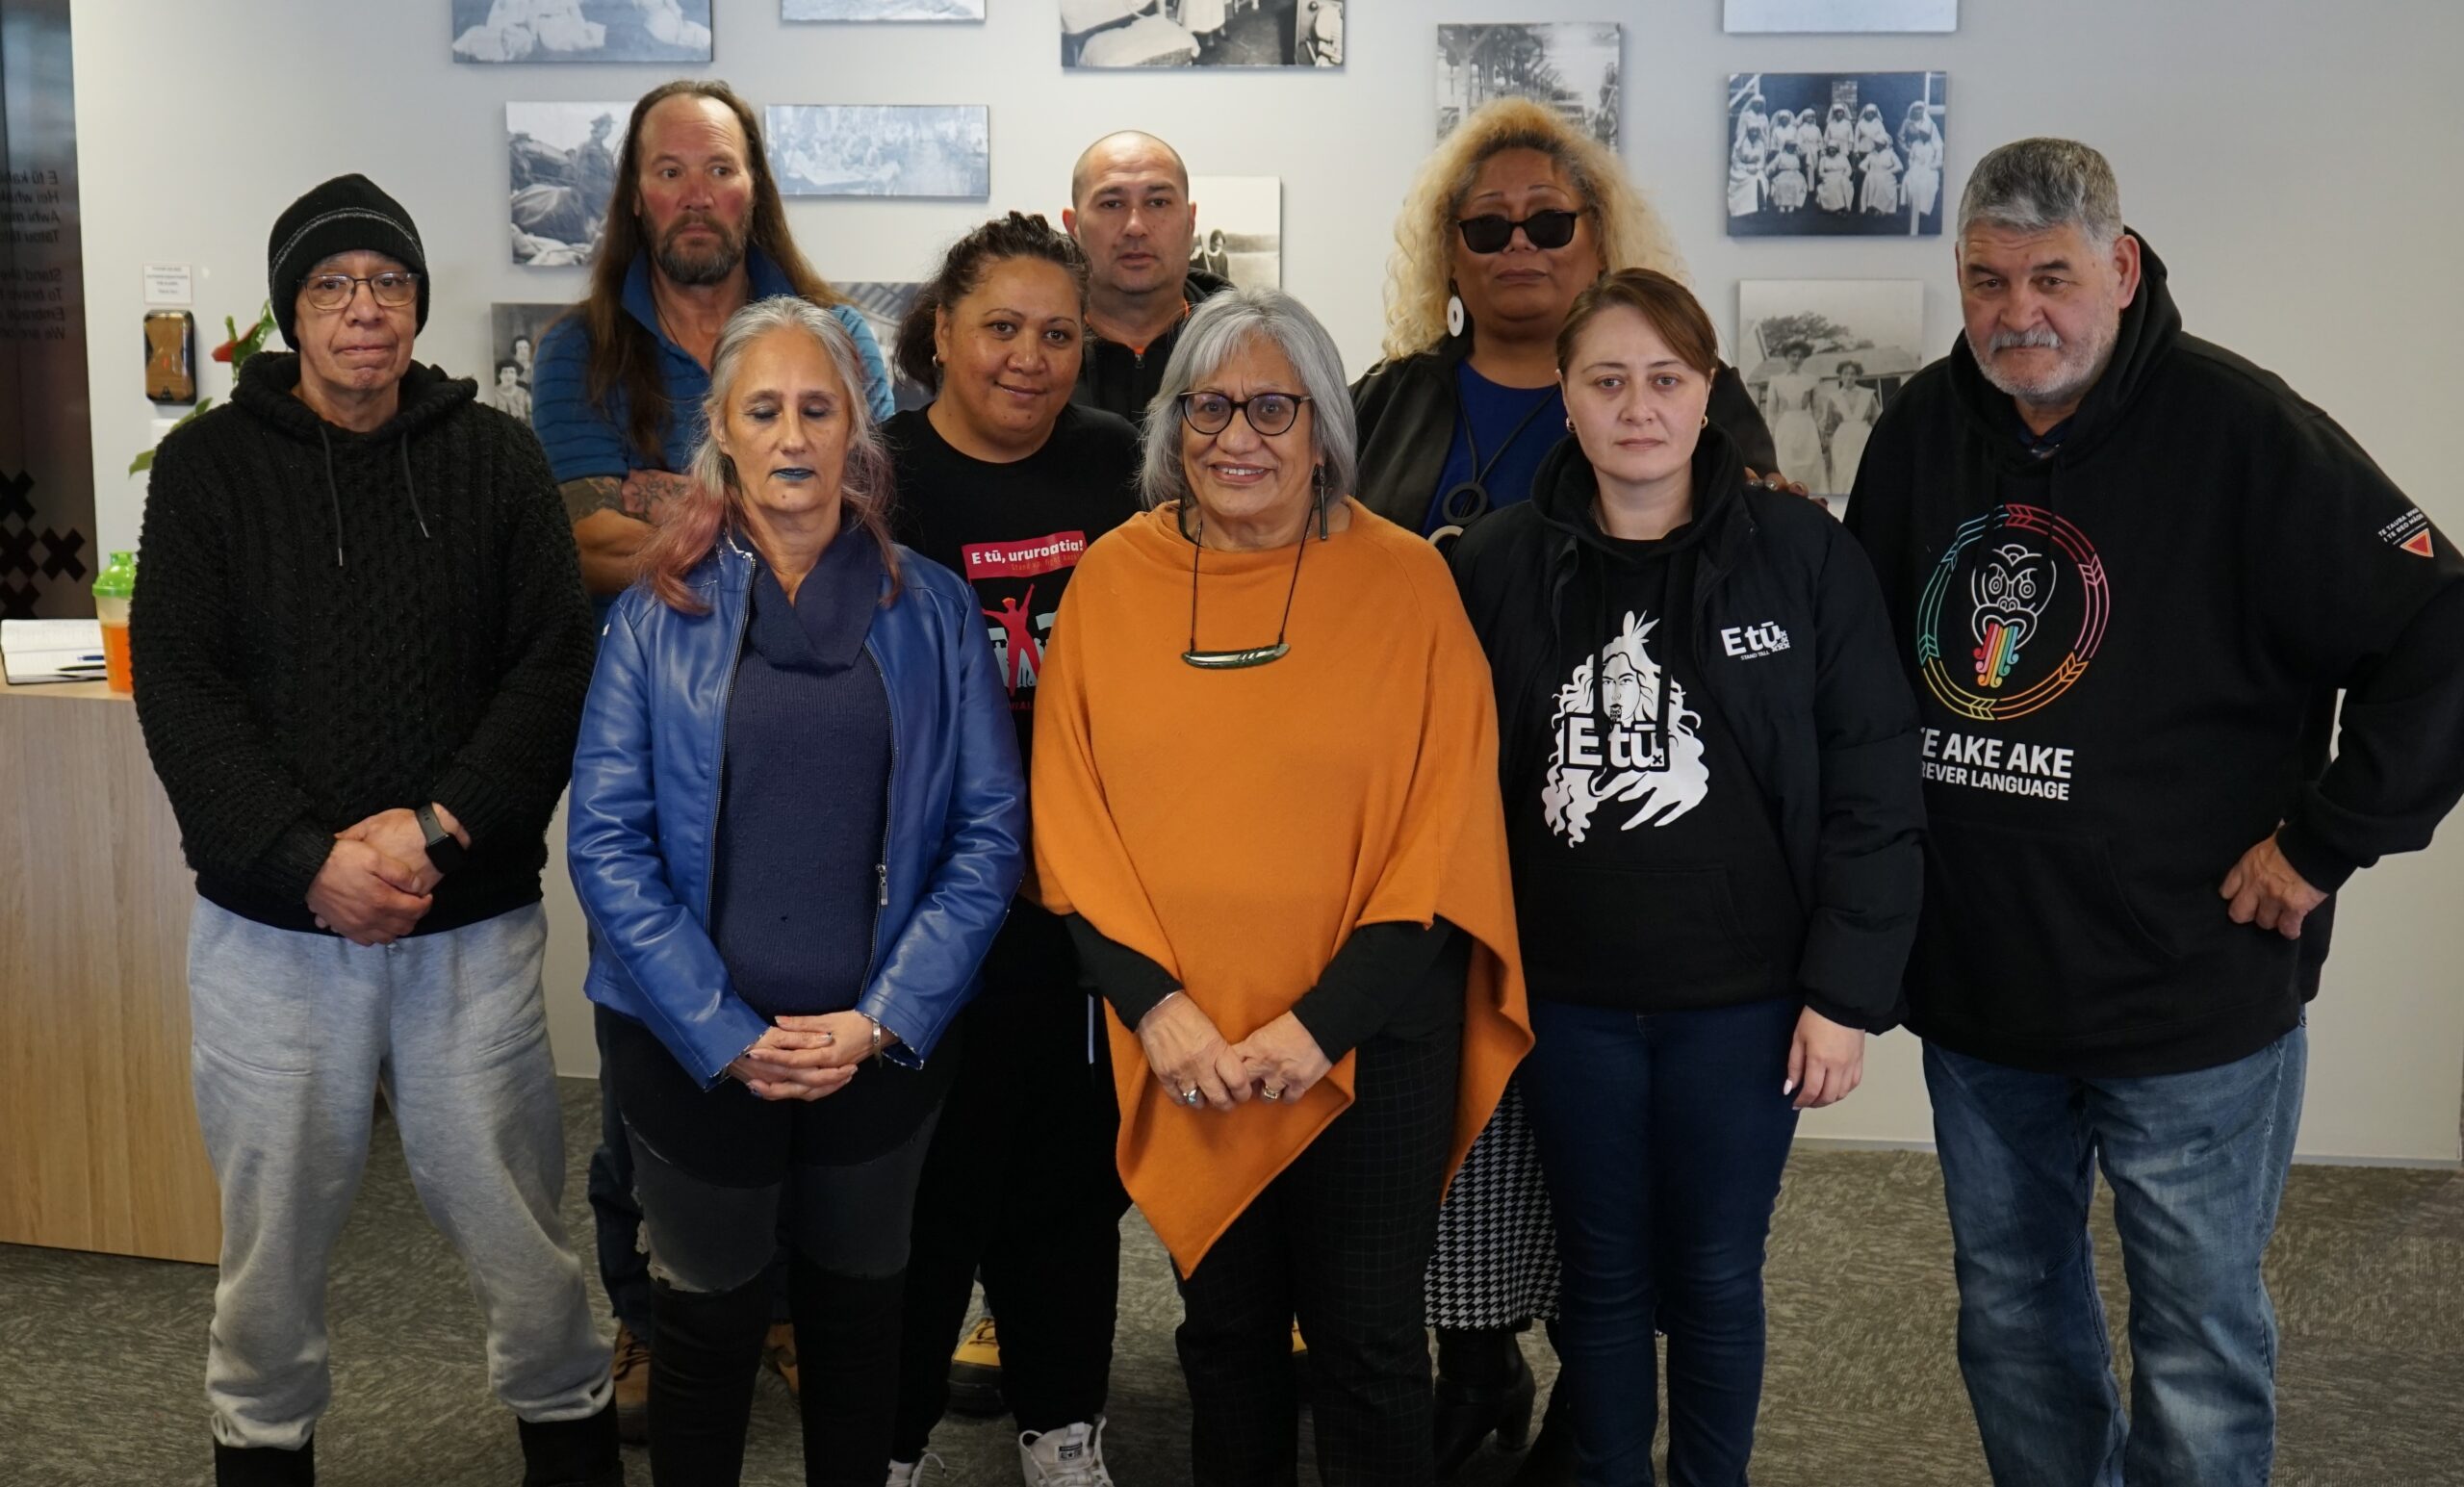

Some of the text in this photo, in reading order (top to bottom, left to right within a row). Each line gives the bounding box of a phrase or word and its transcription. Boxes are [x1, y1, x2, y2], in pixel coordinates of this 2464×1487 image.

[971, 551, 982, 564] E
[1008, 539, 1084, 562] ururoatia!
[1941, 732, 2004, 769] AKE
[2006, 742, 2074, 780] AKE
[1971, 770, 2069, 801] LANGUAGE
